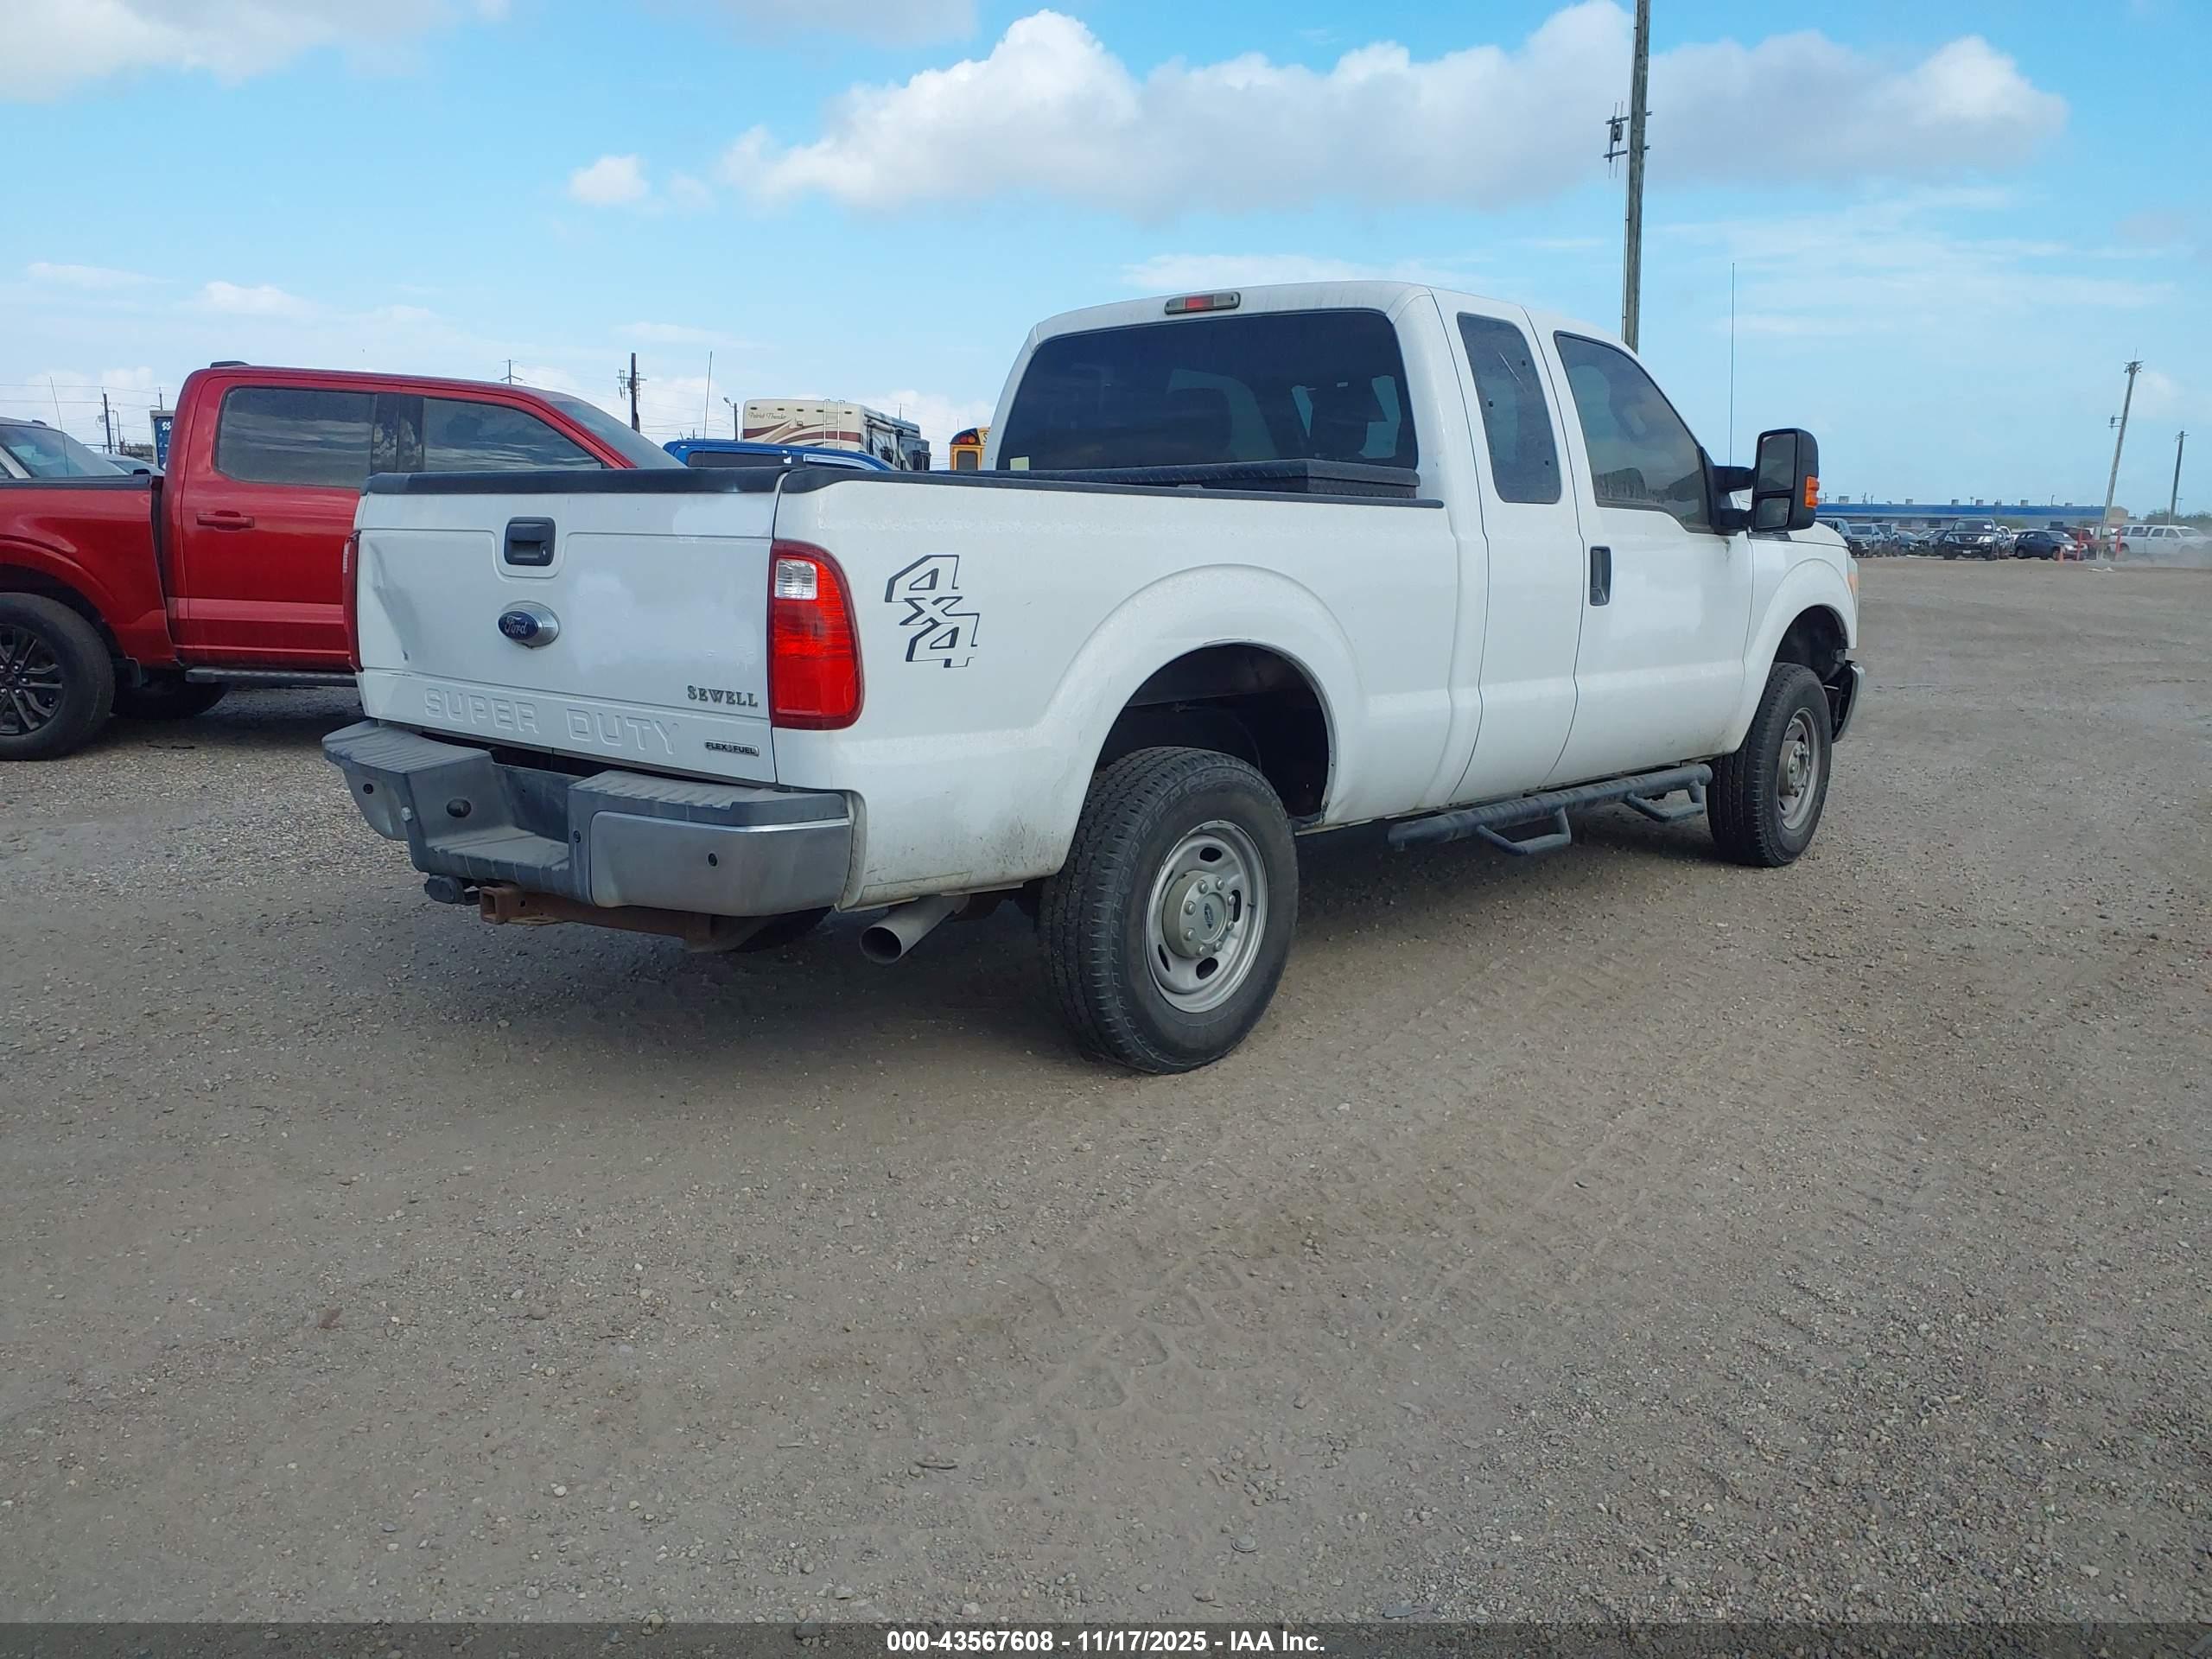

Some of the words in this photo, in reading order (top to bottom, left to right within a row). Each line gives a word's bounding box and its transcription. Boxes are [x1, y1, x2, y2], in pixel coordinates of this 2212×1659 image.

[505, 614, 529, 635] Ford
[687, 684, 759, 708] SEWELL
[423, 687, 541, 734] SUPER
[567, 708, 679, 755] DUTY
[704, 741, 728, 751] FLEX
[733, 744, 756, 754] FUEL
